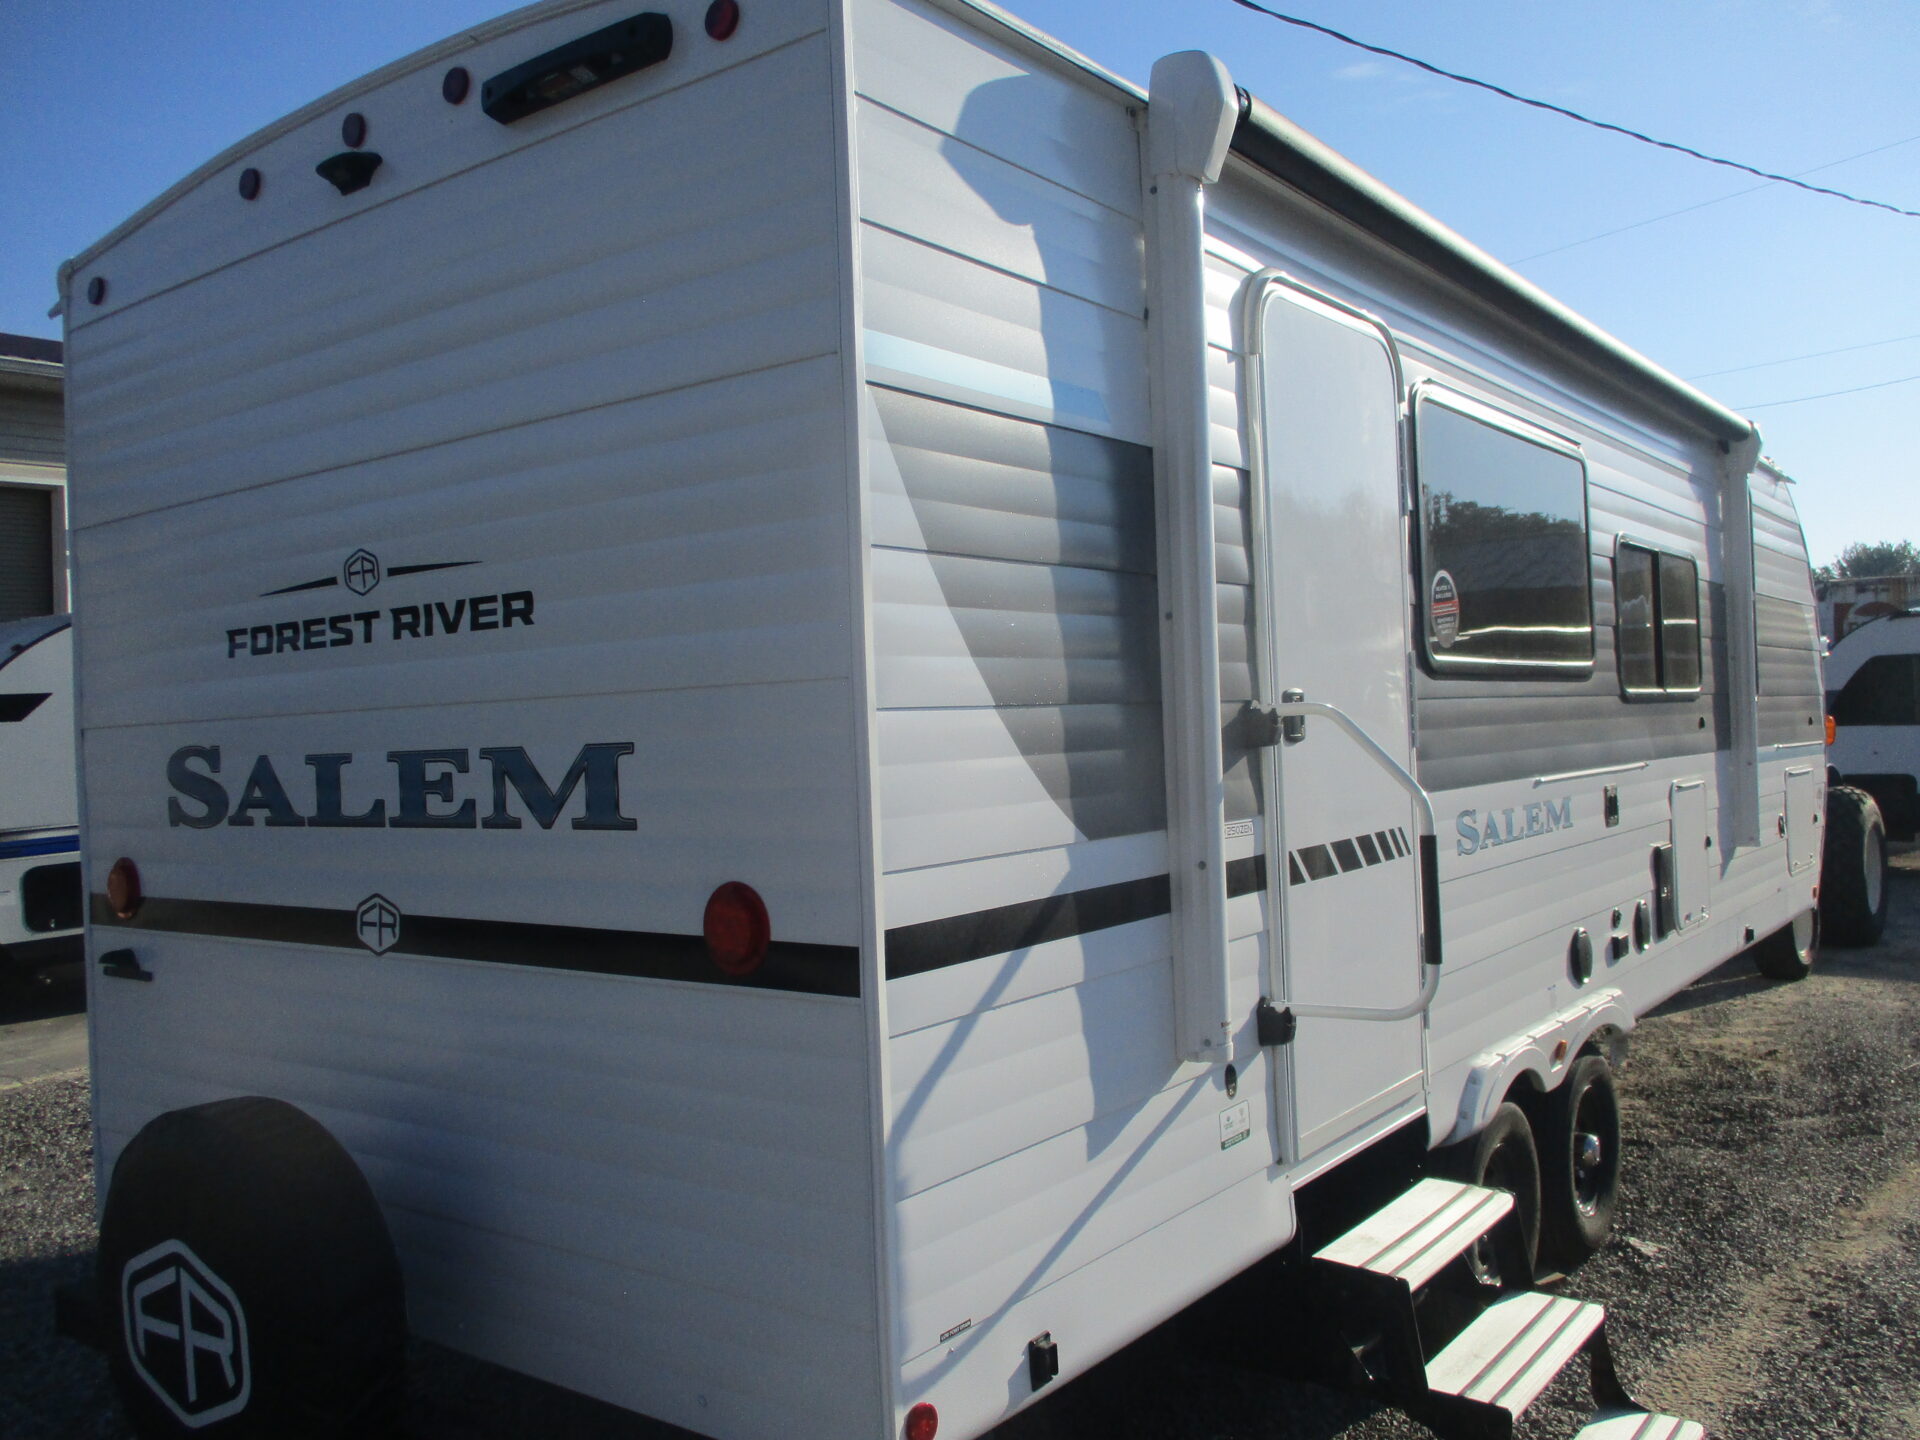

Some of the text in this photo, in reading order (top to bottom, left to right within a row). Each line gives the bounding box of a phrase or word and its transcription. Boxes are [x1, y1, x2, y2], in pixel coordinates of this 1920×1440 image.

[226, 590, 535, 659] FOREST RIVER
[166, 742, 638, 831] SALEM
[1456, 795, 1574, 856] SALEM
